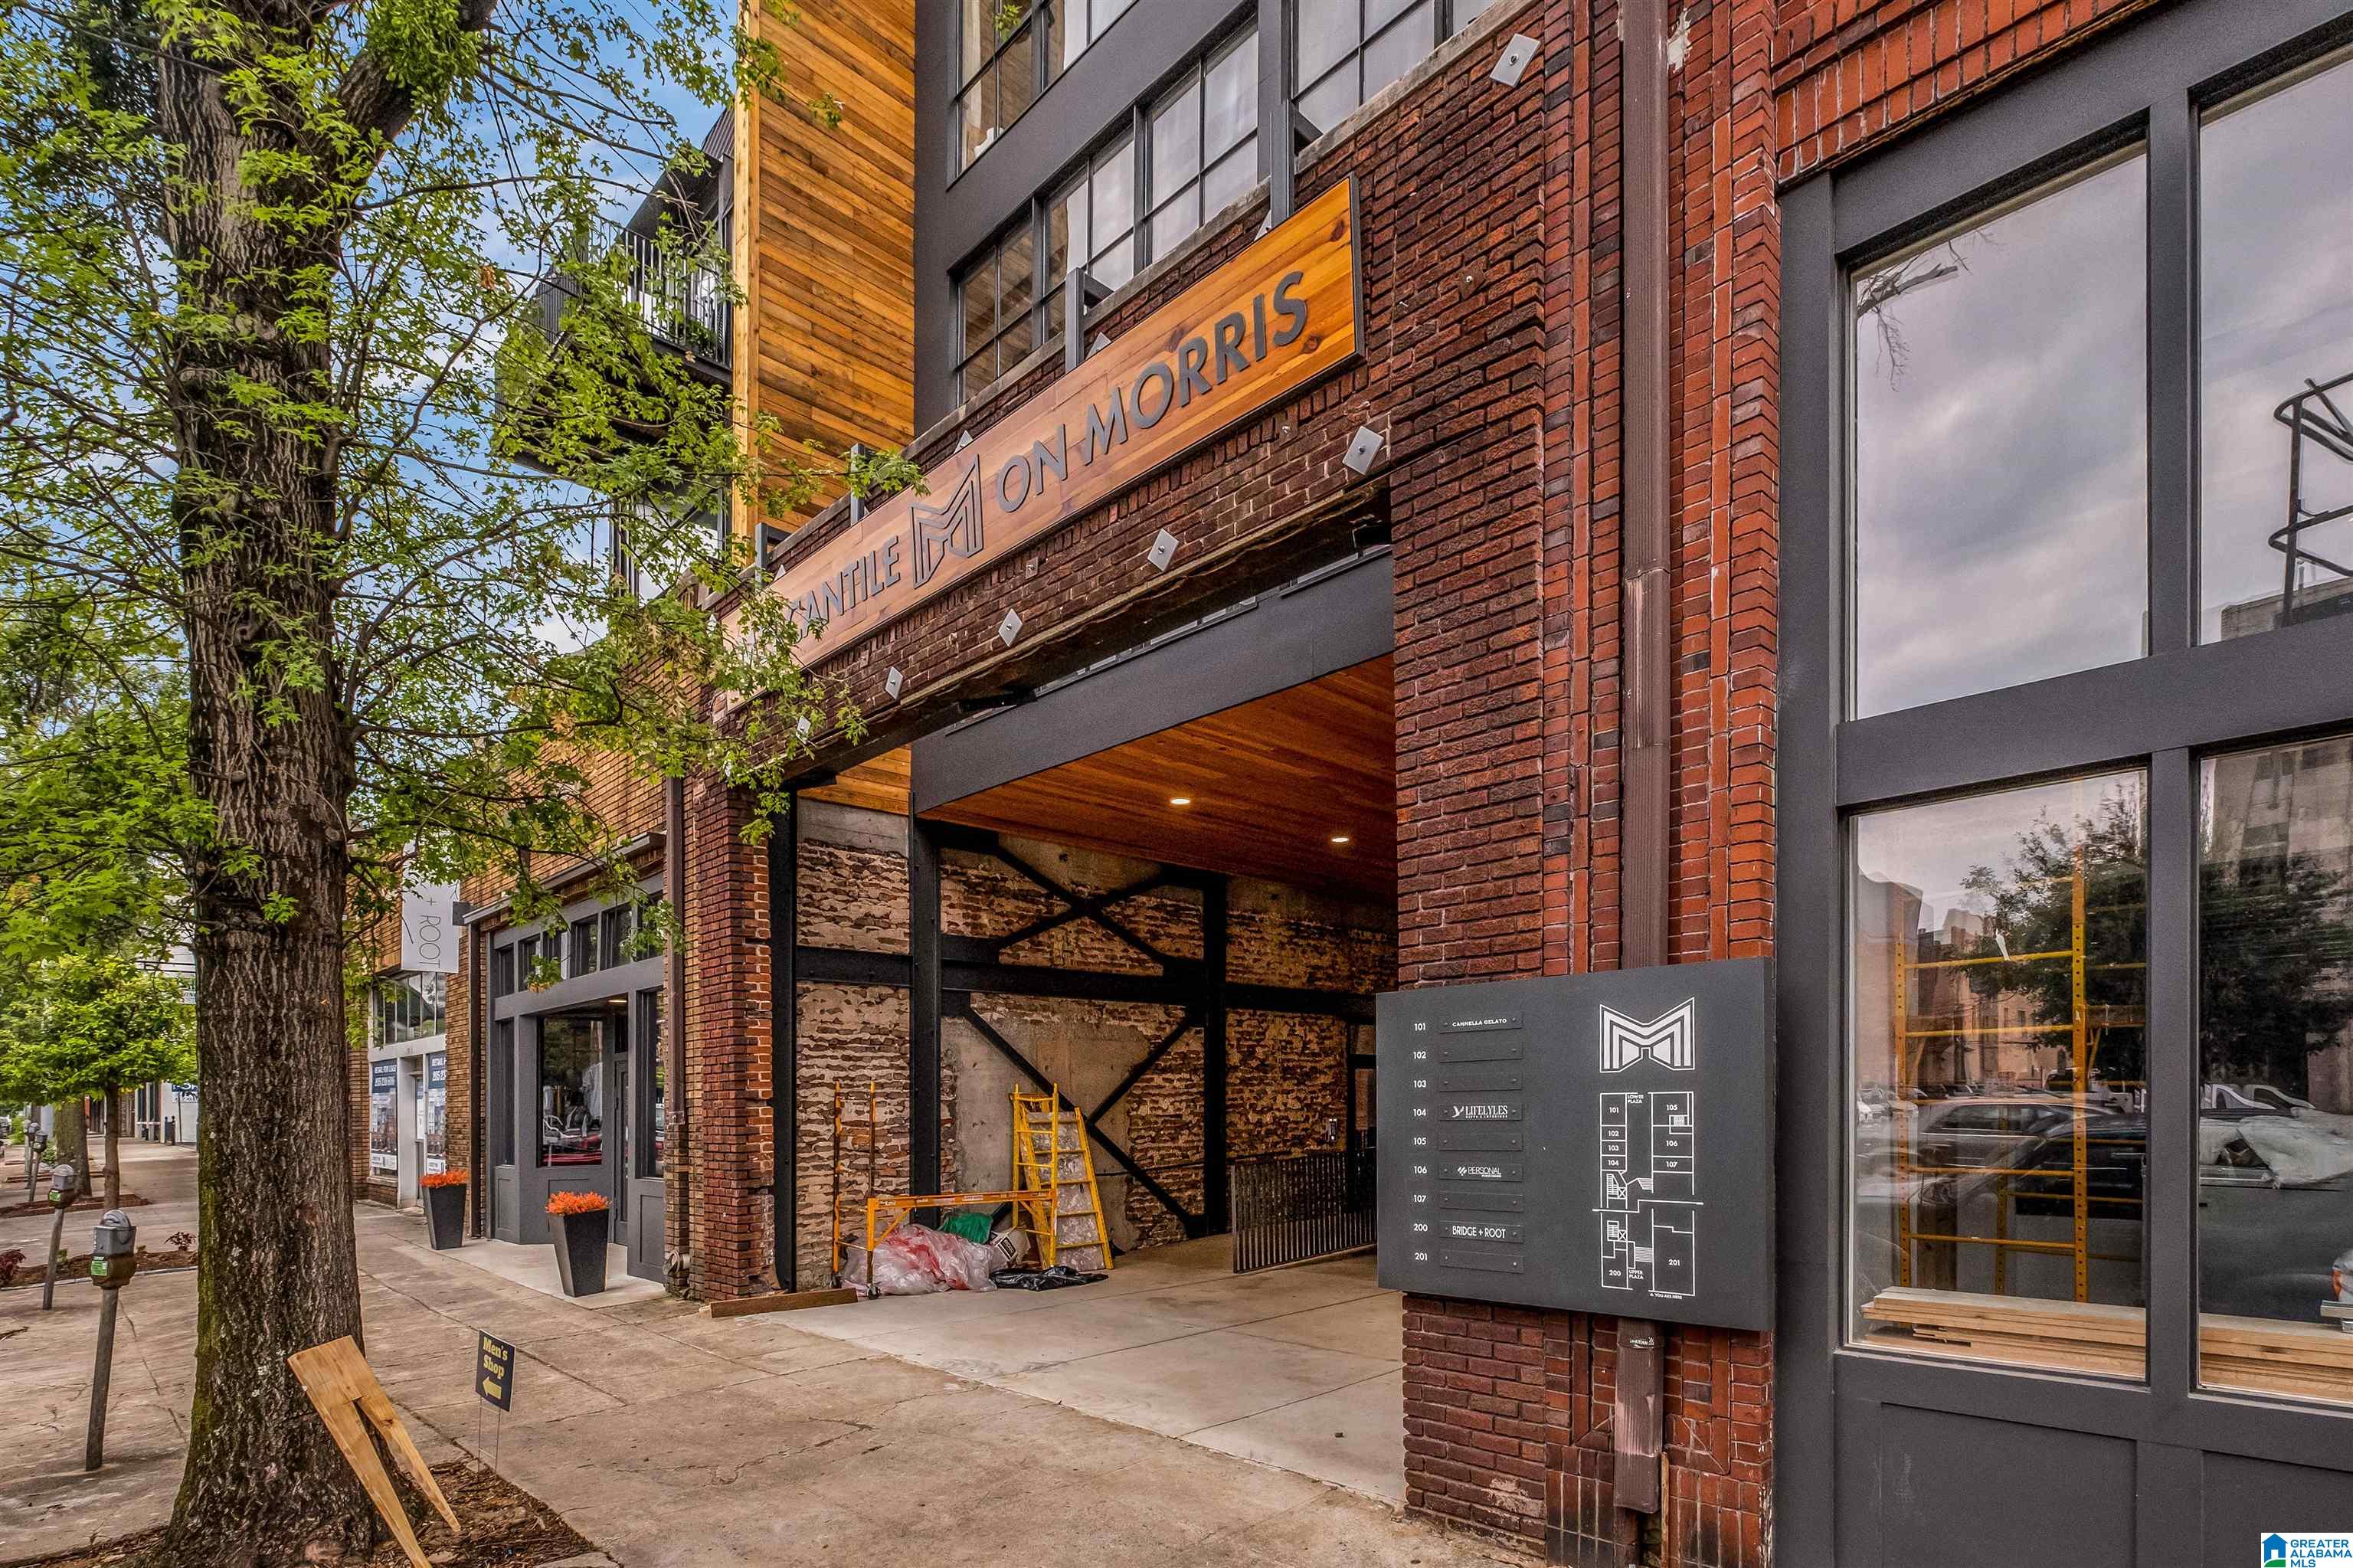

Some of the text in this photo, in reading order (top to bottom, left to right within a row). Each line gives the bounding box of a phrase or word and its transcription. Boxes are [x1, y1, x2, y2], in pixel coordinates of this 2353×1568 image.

[997, 424, 1068, 512] ON
[1084, 270, 1307, 466] MORRIS
[419, 915, 441, 969] ROOT
[1414, 1023, 1426, 1031] 101
[1413, 1051, 1427, 1059] 102
[1413, 1108, 1427, 1117] 104
[1413, 1194, 1427, 1203] 107
[1414, 1223, 1428, 1232] 200
[1452, 1226, 1477, 1237] BRIDGE
[1484, 1229, 1506, 1239] ROOT
[1415, 1252, 1428, 1261] 201
[483, 1336, 509, 1361] Men's
[483, 1354, 505, 1380] Shop
